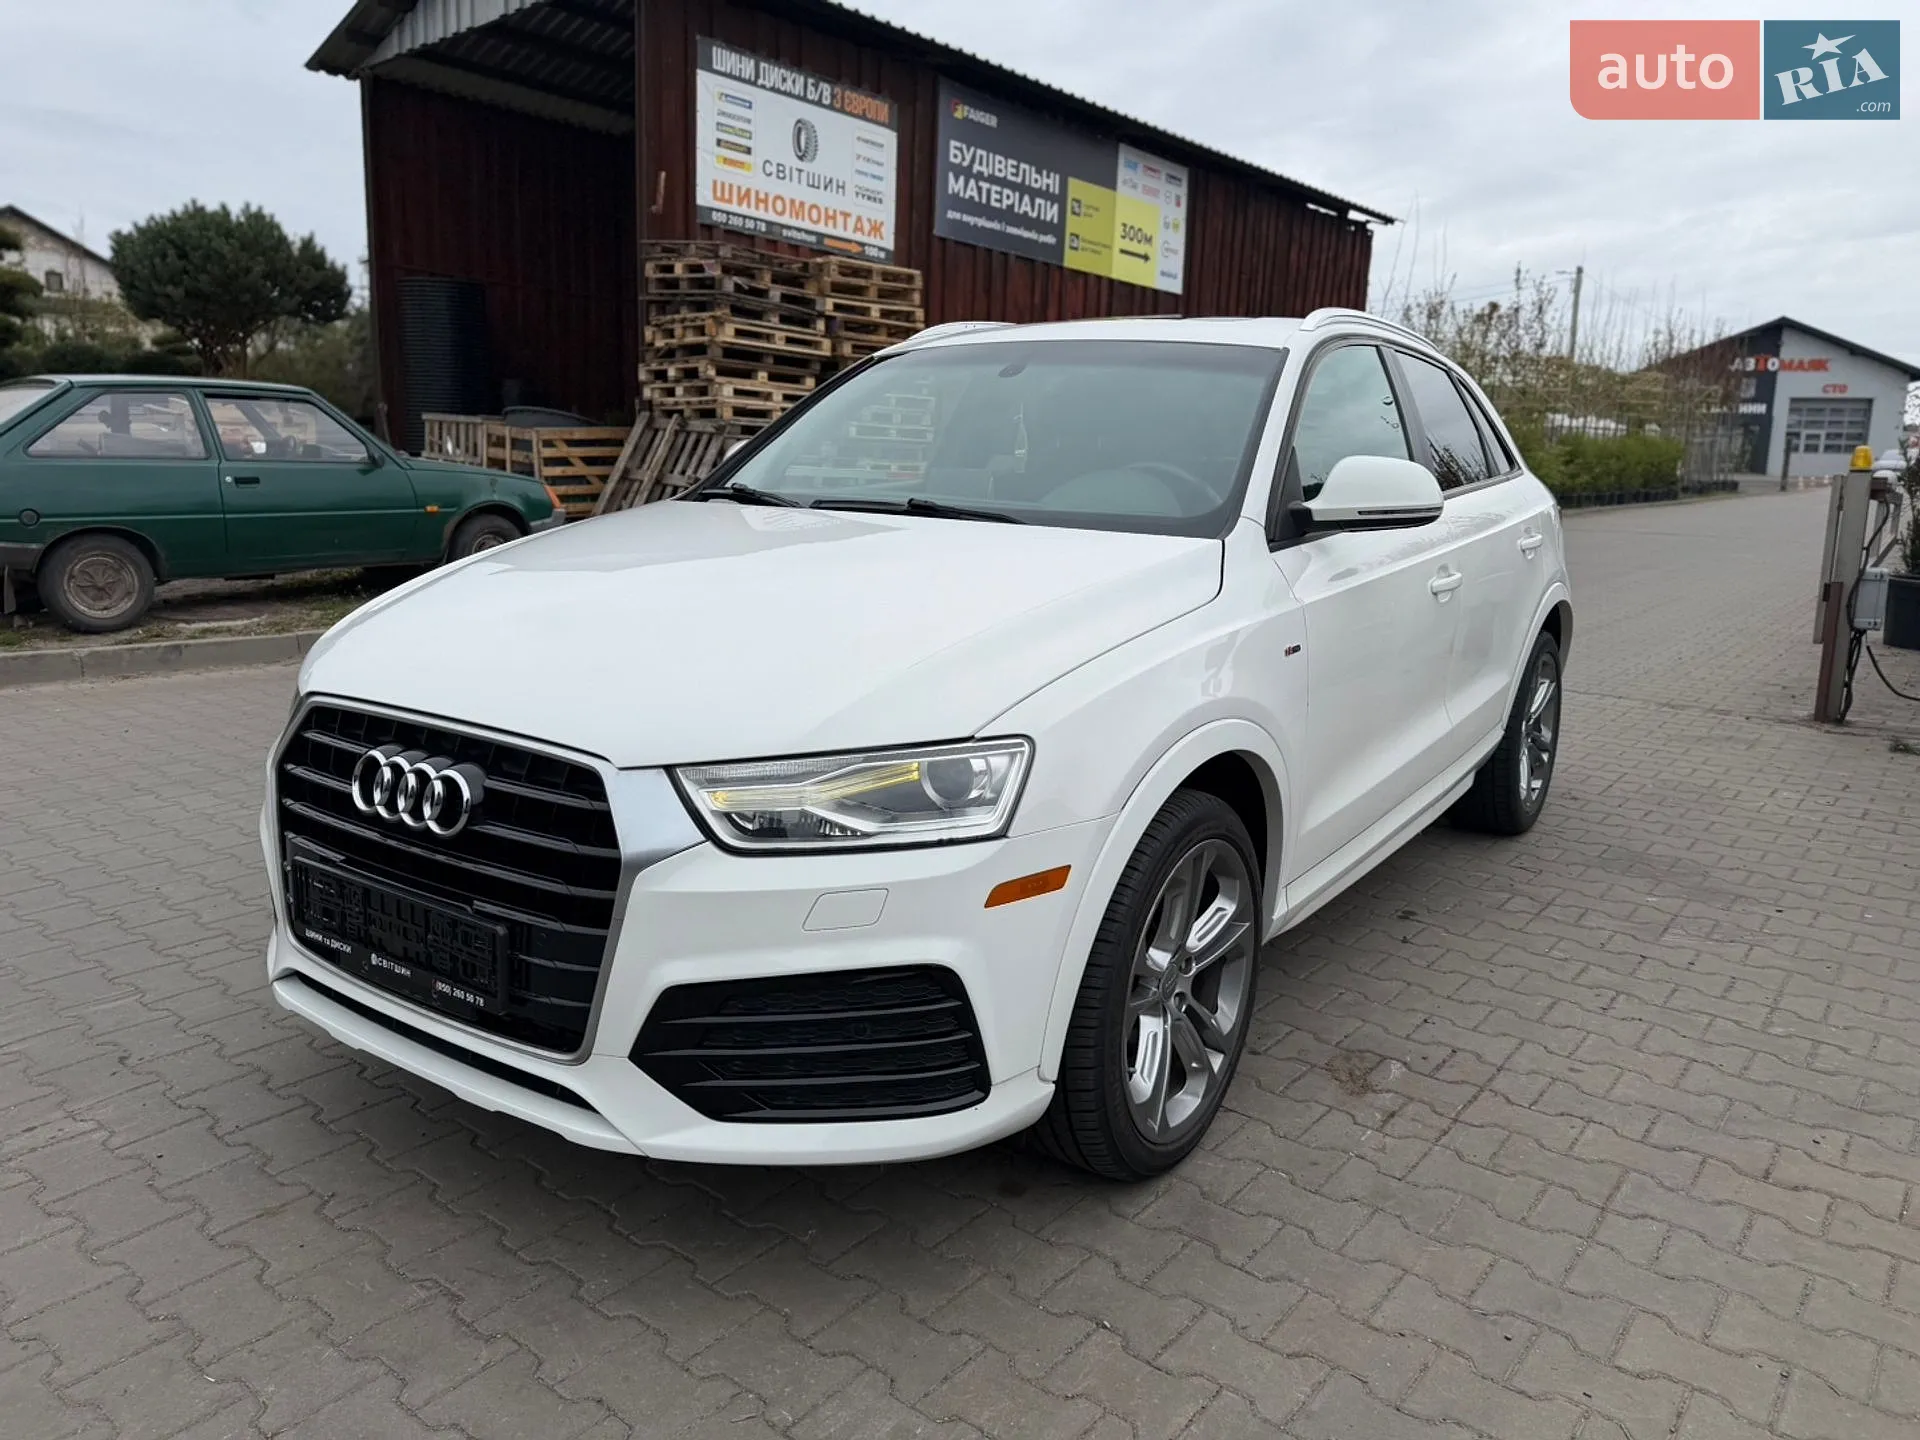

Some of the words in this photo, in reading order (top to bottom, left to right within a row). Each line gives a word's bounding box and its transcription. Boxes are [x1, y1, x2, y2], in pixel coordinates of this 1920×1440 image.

[712, 46, 755, 81] ШИНИ
[757, 62, 805, 96] ДИСКИ
[807, 78, 832, 105] Б/В
[844, 90, 889, 126] ЄВРОПИ
[762, 159, 846, 196] СВІТШИН
[949, 139, 1060, 195] БУДІВЕЛЬНІ
[712, 179, 885, 240] ШИНОМОНТАЖ
[947, 172, 1059, 224] МАТЕРІАЛИ
[378, 957, 412, 978] СВІТШИН
